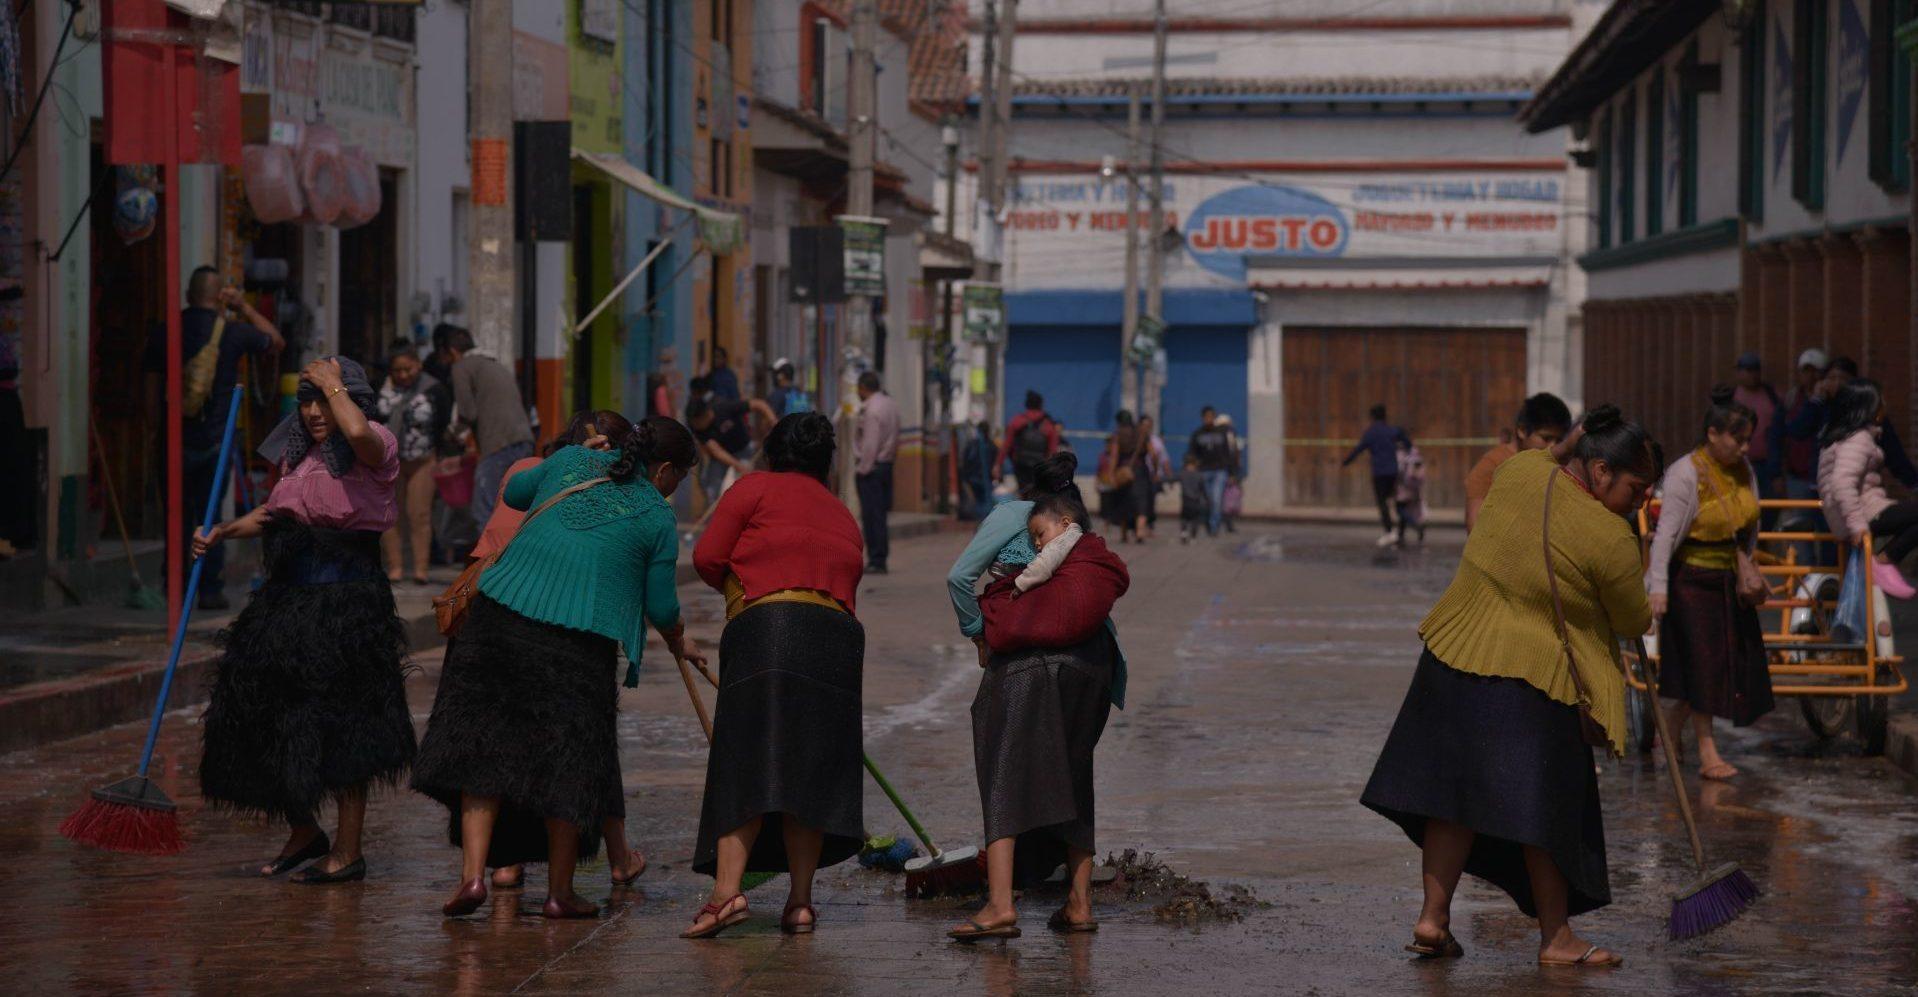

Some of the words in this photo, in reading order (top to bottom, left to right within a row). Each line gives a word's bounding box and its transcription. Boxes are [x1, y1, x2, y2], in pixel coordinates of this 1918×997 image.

[1066, 212, 1081, 229] Y
[1442, 213, 1455, 230] Y
[1191, 219, 1339, 249] JUSTO
